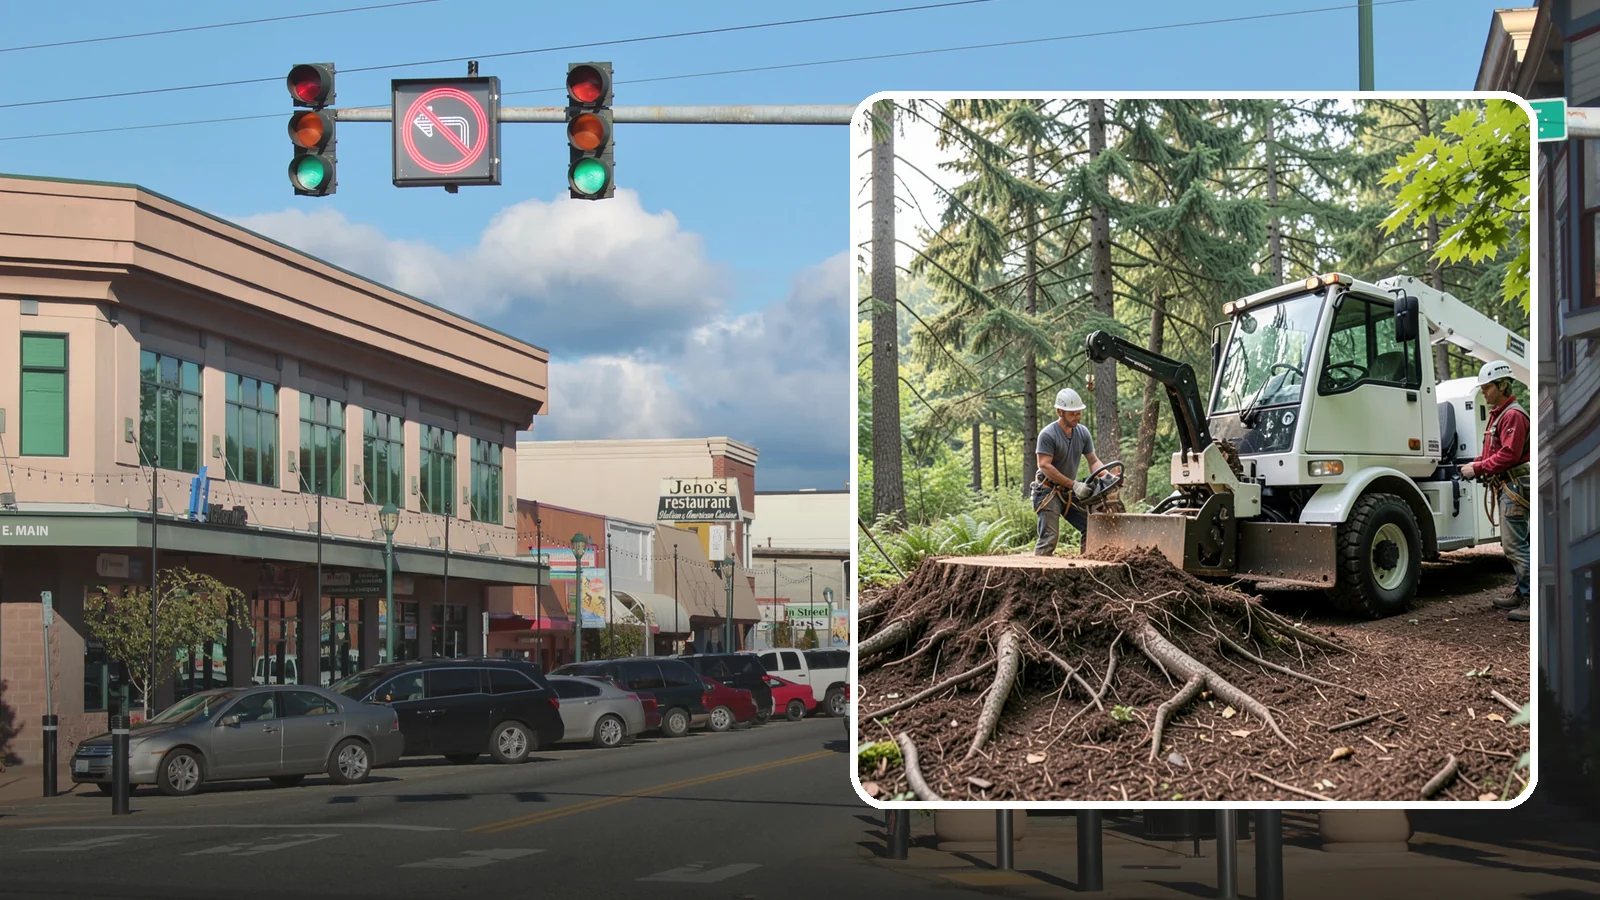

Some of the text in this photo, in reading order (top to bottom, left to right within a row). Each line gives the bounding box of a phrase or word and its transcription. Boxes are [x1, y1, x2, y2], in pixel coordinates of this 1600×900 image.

[670, 480, 728, 495] Jeno's
[665, 496, 731, 509] restaurant
[658, 510, 682, 519] Italian
[686, 510, 715, 519] American
[715, 509, 738, 519] Cuisine
[2, 525, 49, 536] E. MAIN
[797, 608, 828, 616] Street
